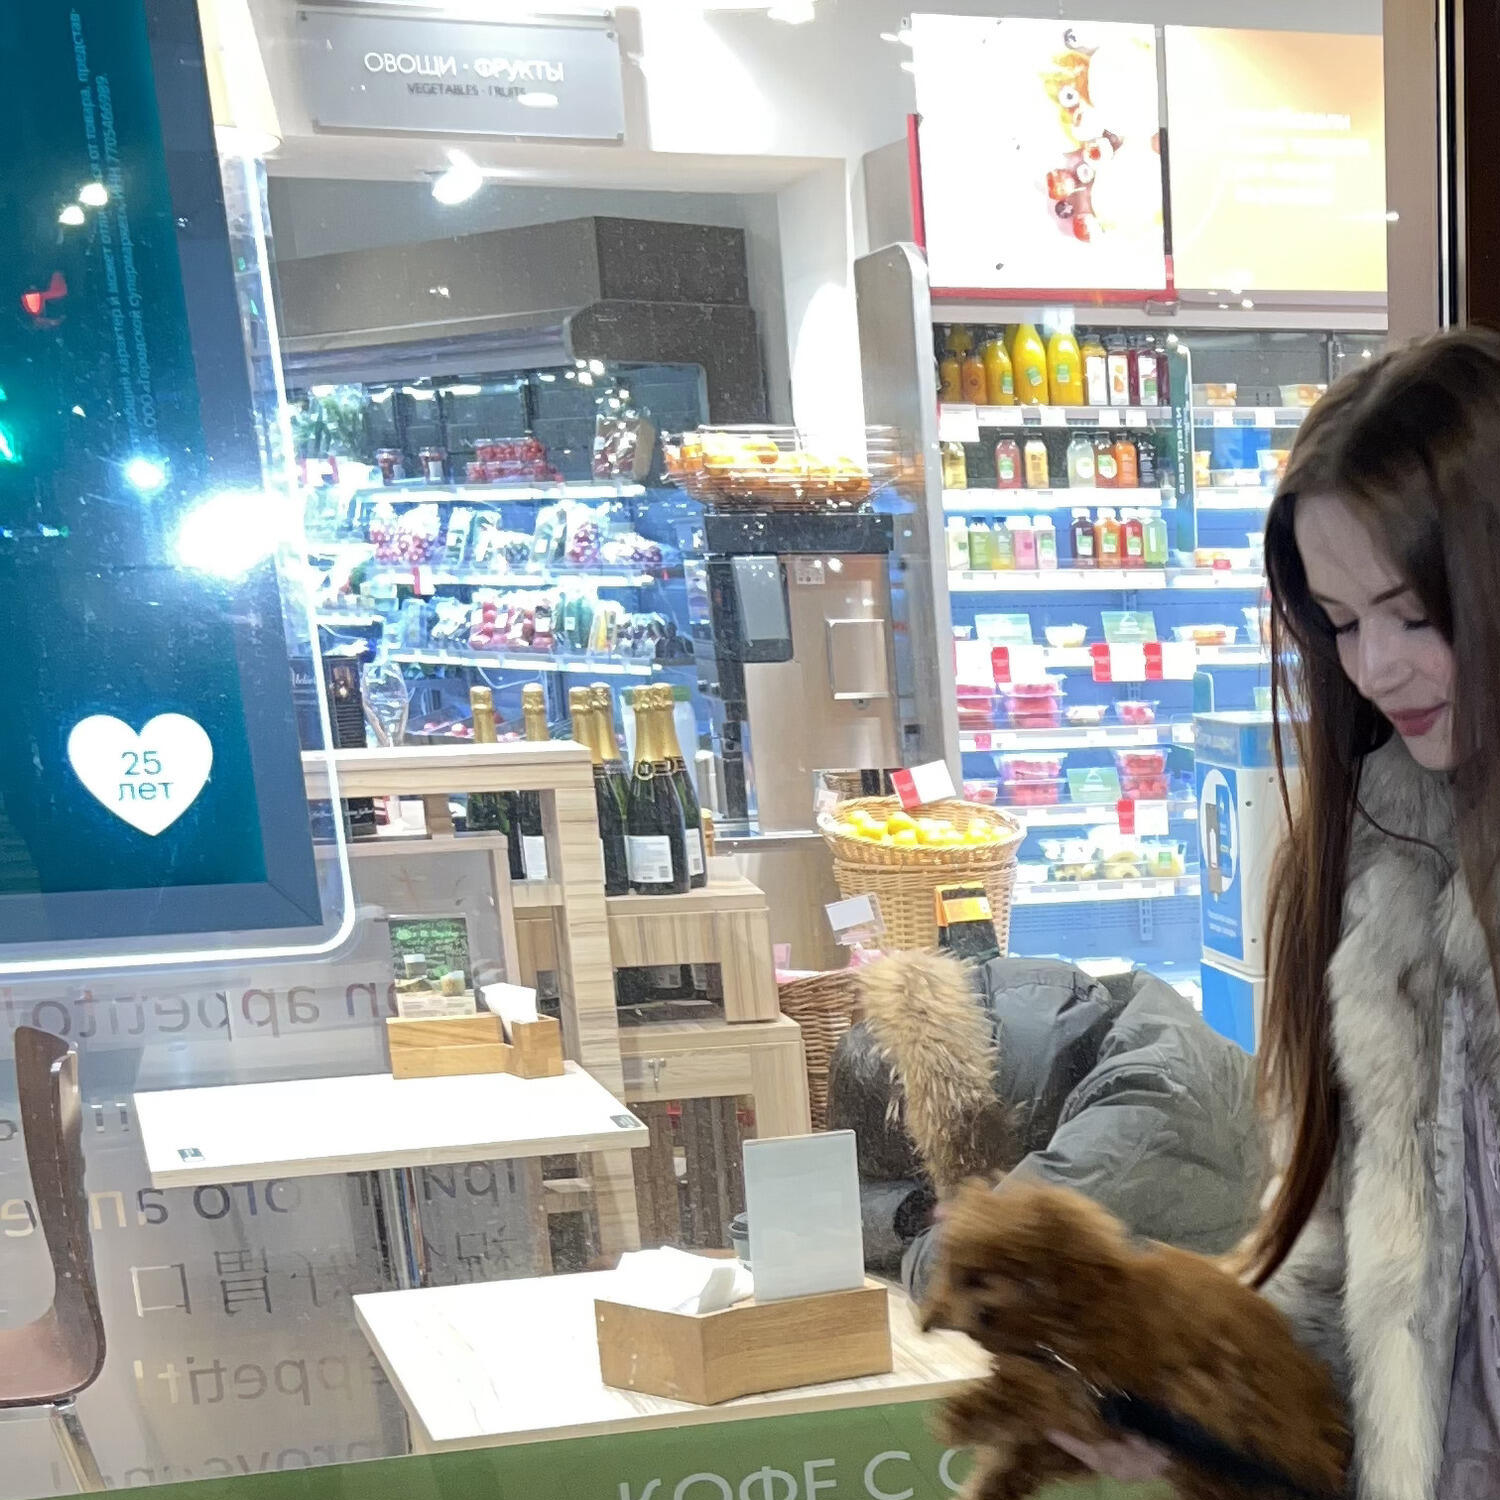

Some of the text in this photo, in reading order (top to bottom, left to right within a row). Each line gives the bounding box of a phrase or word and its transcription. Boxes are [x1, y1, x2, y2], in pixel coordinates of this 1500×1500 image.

[70, 8, 89, 82] представ-
[363, 52, 565, 82] ОВОЩИ ФРУКТЫ
[406, 82, 479, 97] VEGETABLES
[79, 86, 96, 139] товара,
[87, 142, 101, 160] от
[108, 166, 126, 200] ИНН
[103, 248, 118, 293] может
[111, 309, 130, 373] характер
[138, 394, 158, 428] ООО
[120, 750, 162, 776] 25
[117, 780, 175, 802] лет
